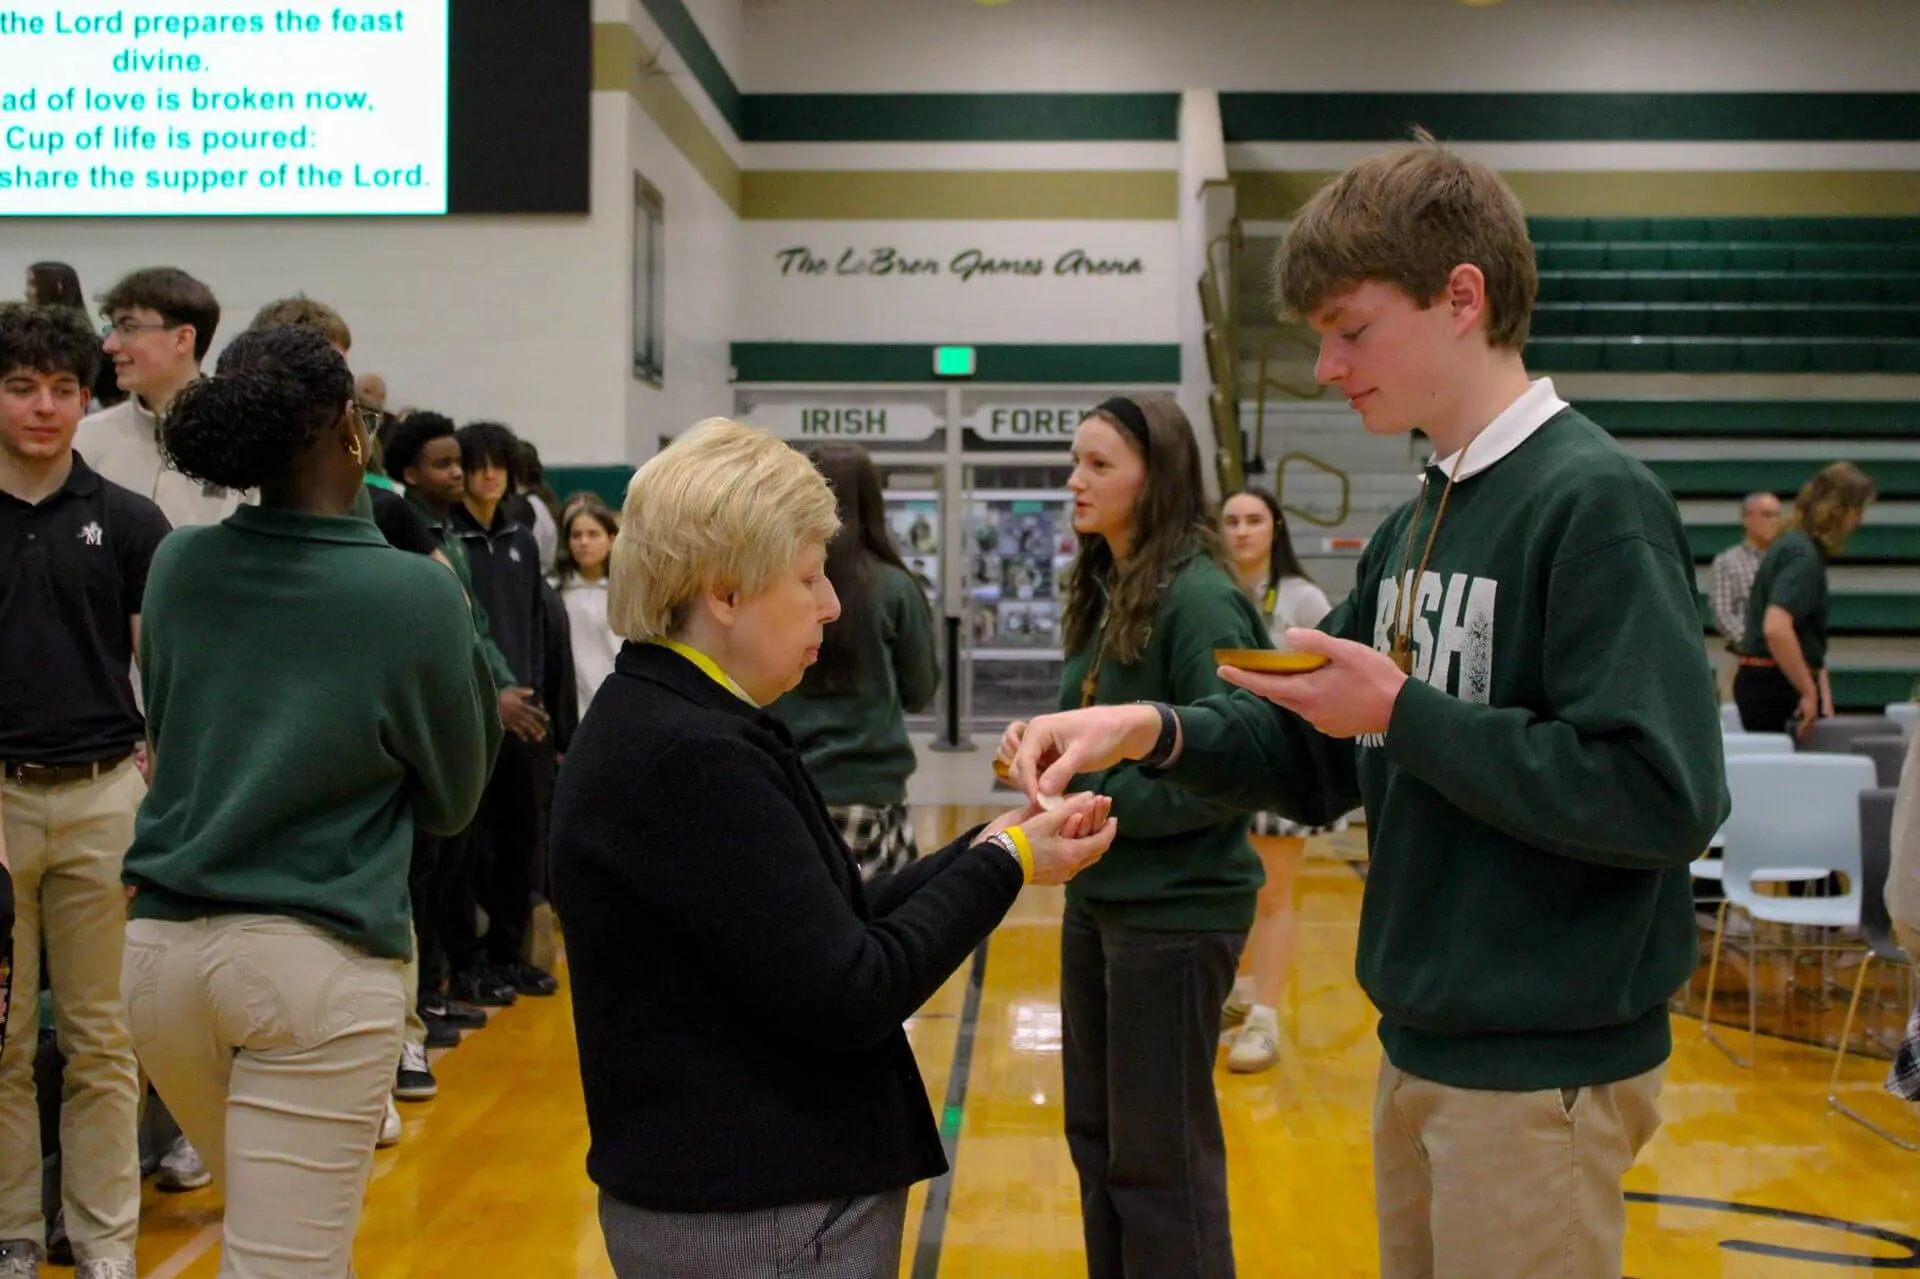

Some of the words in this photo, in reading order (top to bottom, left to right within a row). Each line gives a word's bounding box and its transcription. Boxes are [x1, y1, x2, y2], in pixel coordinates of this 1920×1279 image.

[0, 10, 45, 34] the
[55, 10, 123, 34] Lord
[134, 8, 265, 40] prepares
[274, 8, 321, 33] the
[331, 7, 404, 33] feast
[111, 47, 210, 73] divine.
[47, 86, 76, 112] of
[85, 86, 147, 112] love
[156, 85, 181, 112] is
[191, 84, 296, 111] broken
[304, 89, 375, 113] now,
[5, 124, 66, 156] Cup
[74, 123, 105, 151] of
[113, 123, 157, 151] life
[167, 124, 192, 151] is
[202, 123, 316, 156] poured:
[0, 163, 80, 190] share
[89, 162, 135, 190] the
[145, 167, 249, 194] supper
[258, 162, 288, 189] of
[297, 162, 343, 189] the
[354, 162, 431, 189] Lord.
[775, 246, 828, 277] The
[836, 246, 939, 276] LeBron
[951, 248, 1044, 282] James
[1053, 248, 1143, 276] Arena
[801, 408, 887, 436] IRISH
